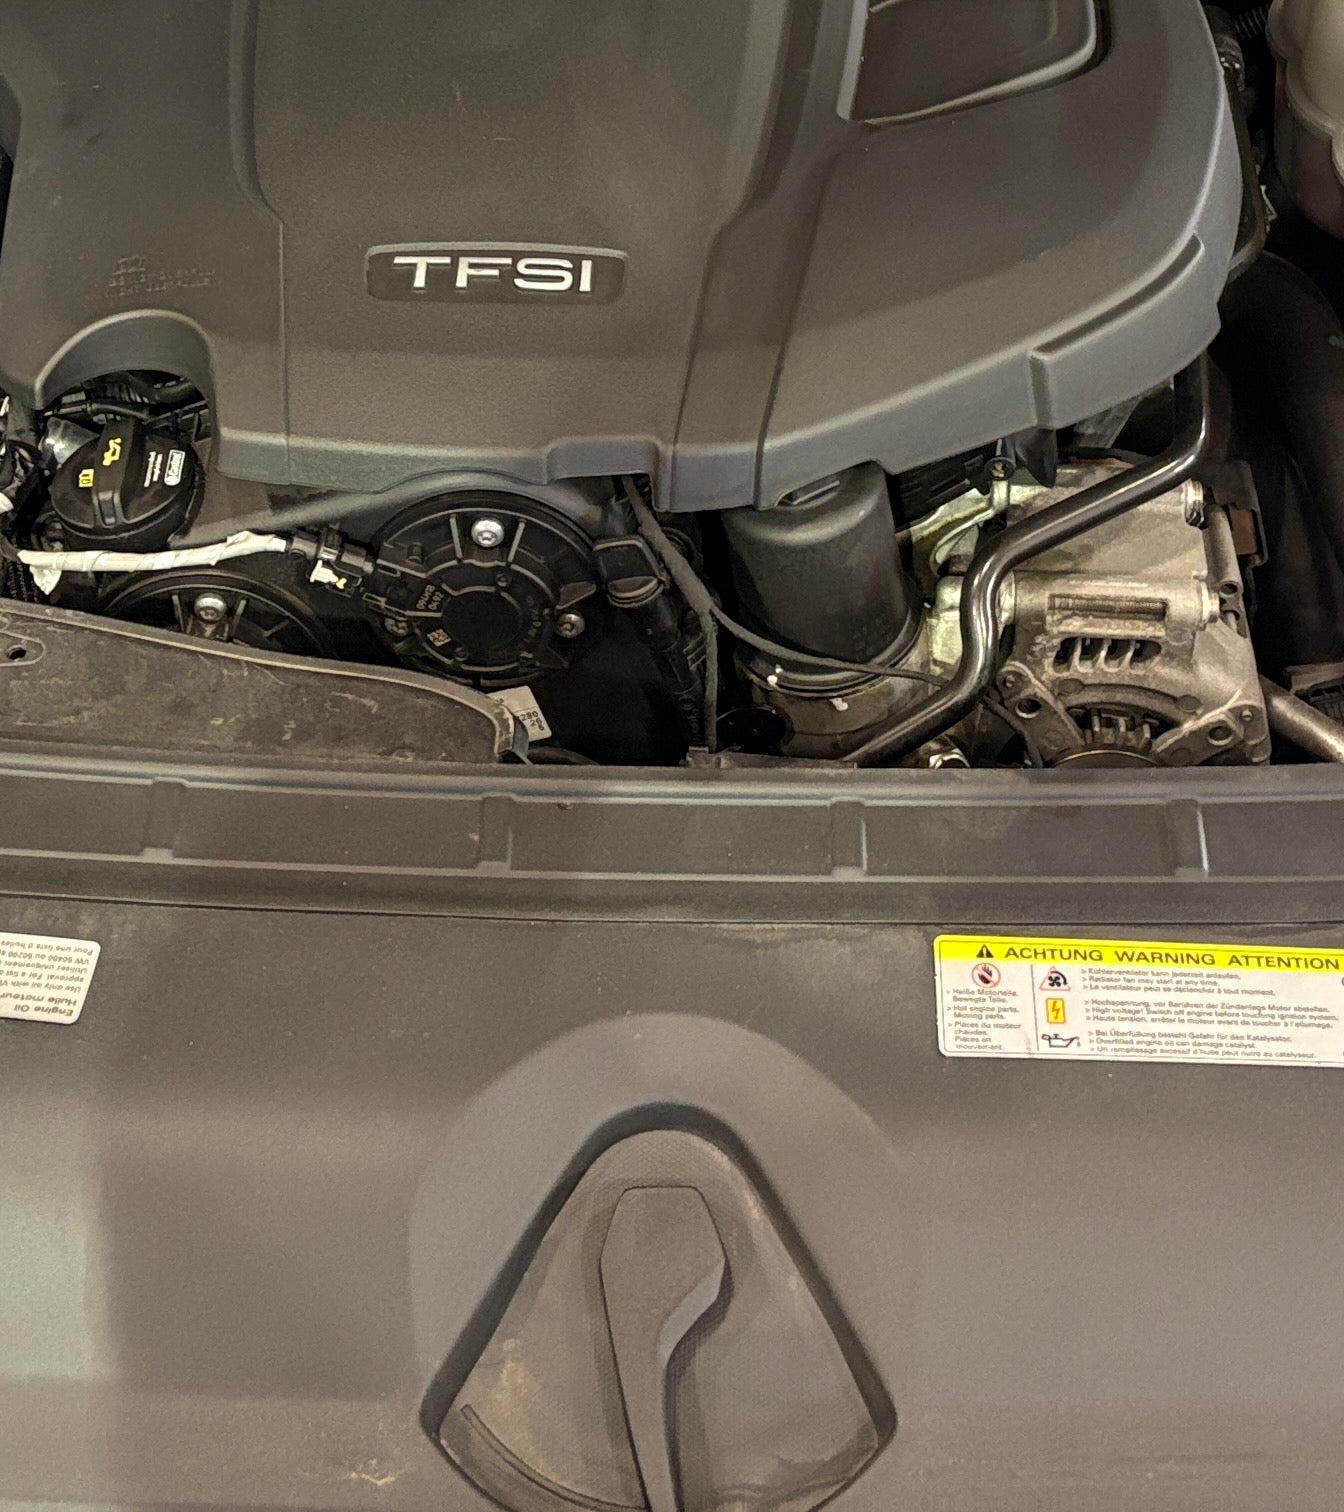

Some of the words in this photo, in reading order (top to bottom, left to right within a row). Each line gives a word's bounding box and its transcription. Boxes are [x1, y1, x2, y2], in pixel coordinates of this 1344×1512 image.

[393, 255, 593, 292] TFSI
[1004, 947, 1104, 961] ACHTUNG
[1116, 951, 1216, 966] WARNING
[1227, 956, 1340, 970] ATTENTION
[13, 1003, 31, 1013] Oil
[32, 1005, 75, 1017] Engine
